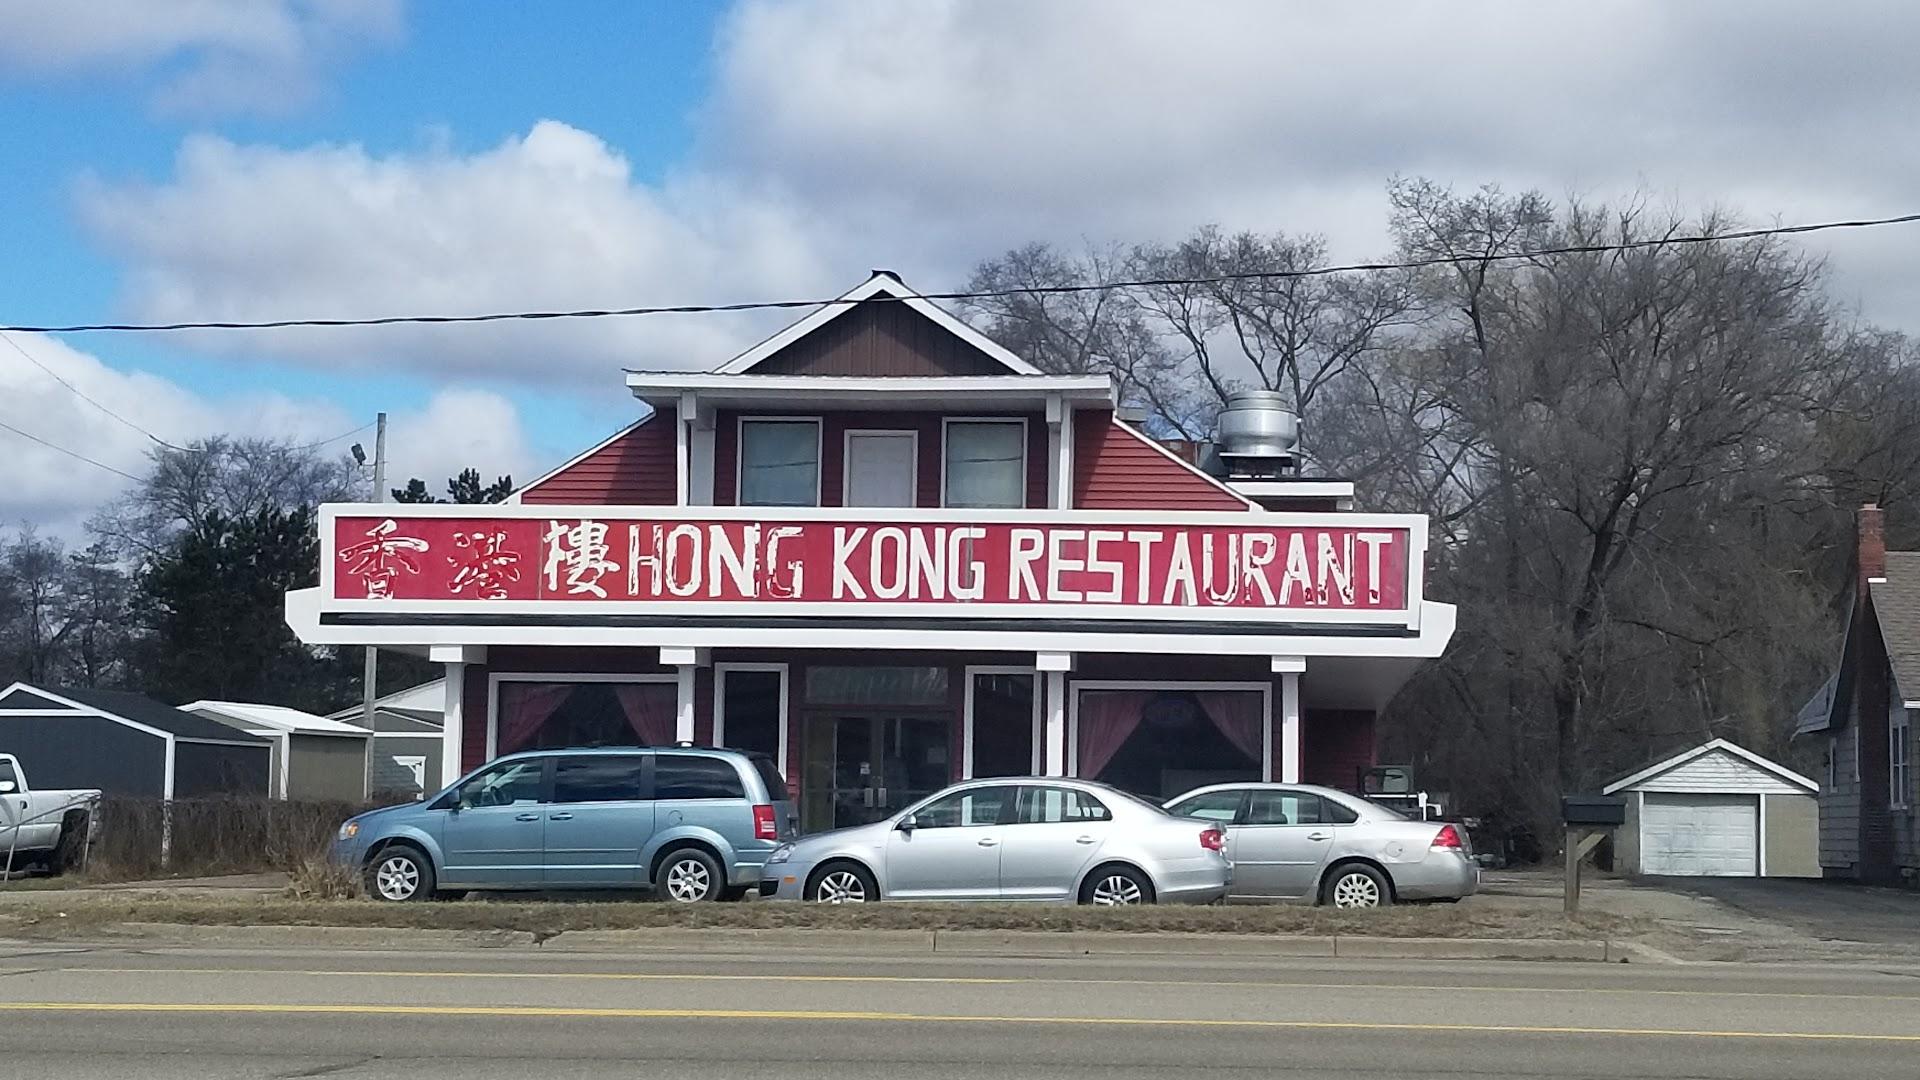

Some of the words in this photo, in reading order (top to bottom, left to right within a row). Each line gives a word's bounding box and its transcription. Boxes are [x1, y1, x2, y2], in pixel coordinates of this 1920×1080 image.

[627, 523, 804, 599] HONG
[832, 526, 986, 601] KONG
[1008, 527, 1393, 606] RESTAURANT
